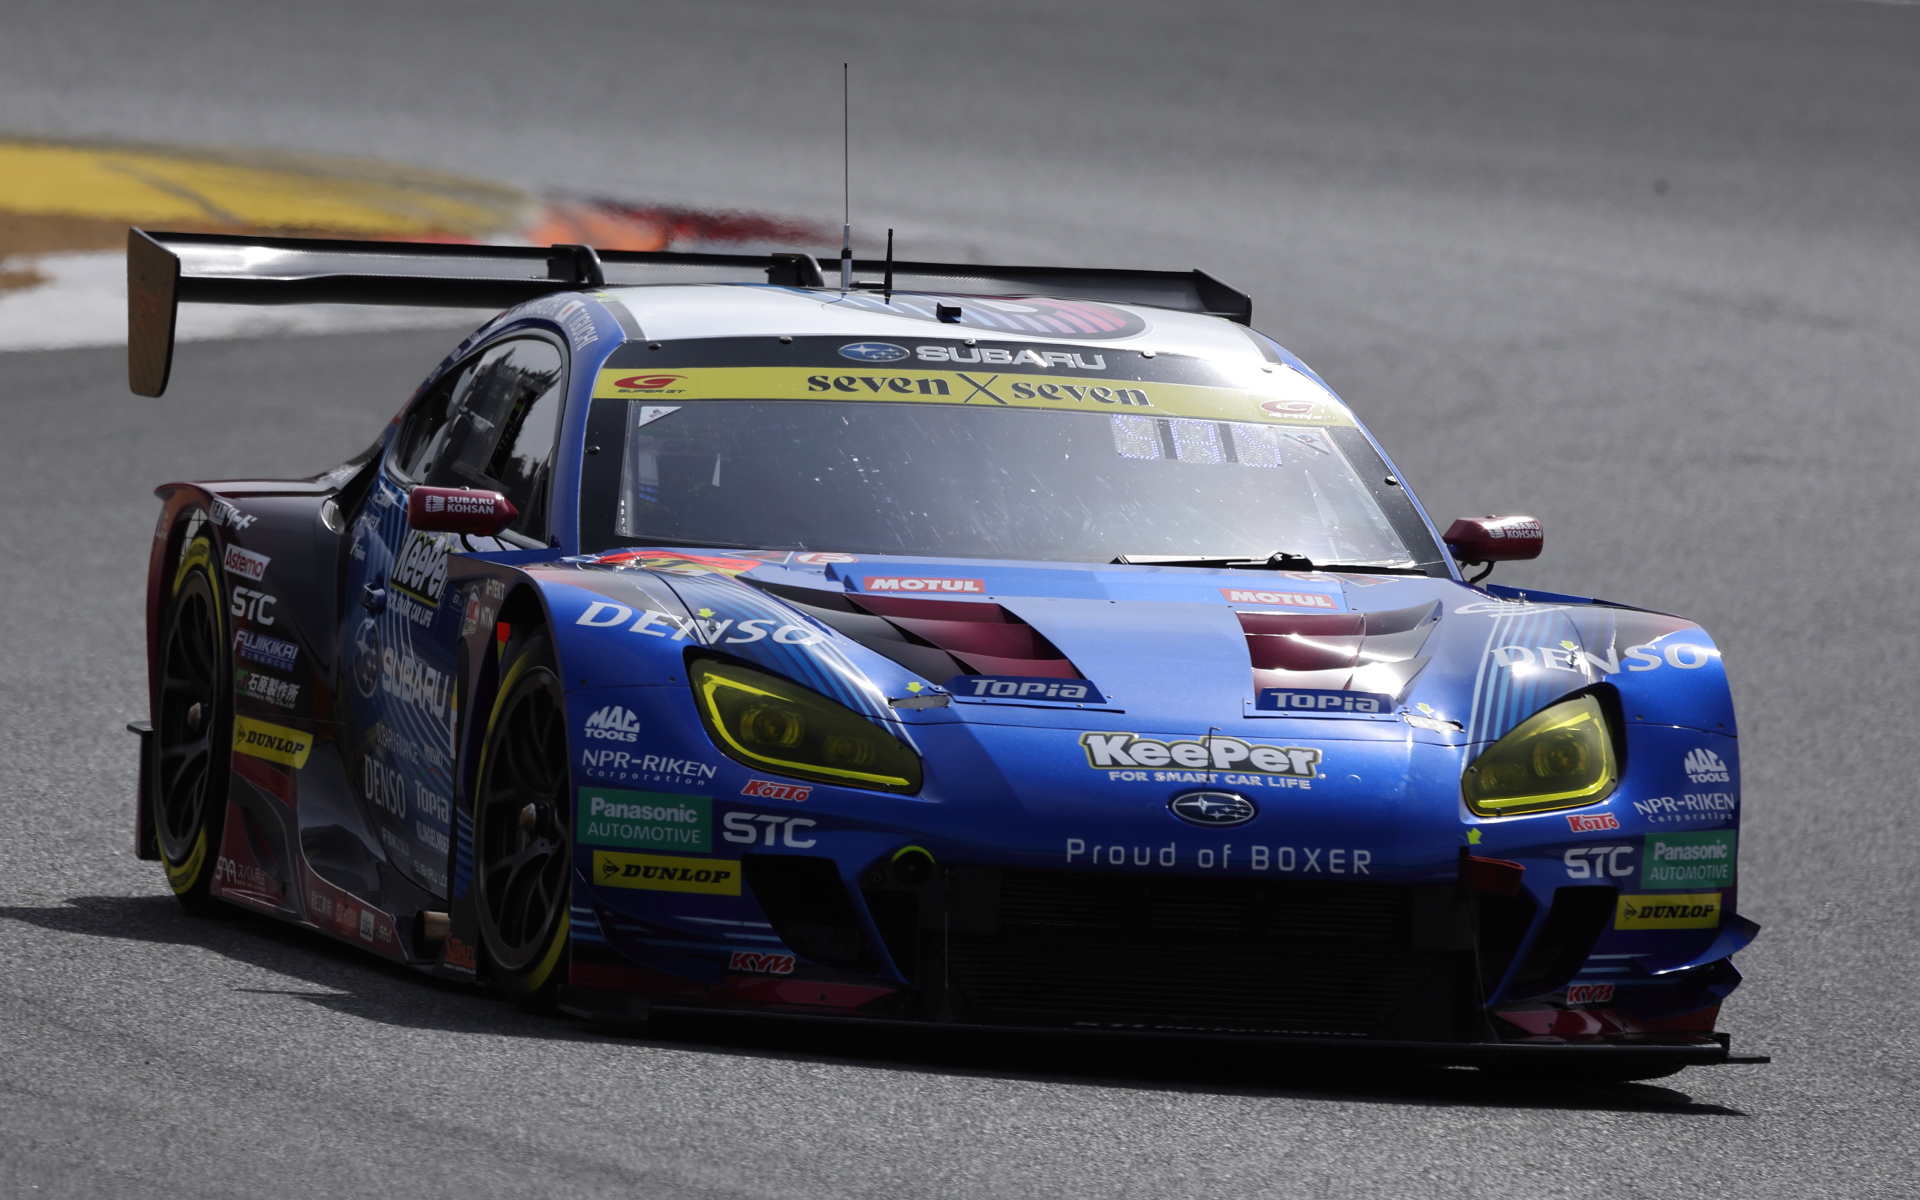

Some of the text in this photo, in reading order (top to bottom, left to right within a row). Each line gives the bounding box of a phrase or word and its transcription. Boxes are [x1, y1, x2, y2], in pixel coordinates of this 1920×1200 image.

[915, 345, 1106, 370] SUBARU
[807, 375, 952, 396] seven
[1012, 382, 1155, 407] seven
[447, 496, 495, 506] SUBARU
[447, 504, 494, 515] KOHSAN
[1506, 530, 1542, 539] KOHSAN
[225, 547, 264, 577] Astemo
[870, 578, 980, 592] MOTUL
[231, 585, 278, 626] STC
[1229, 590, 1332, 607] MOTUL
[410, 604, 422, 623] CAR
[419, 609, 434, 629] LIFE
[480, 606, 494, 631] NTN
[574, 601, 825, 645] DENSO
[233, 630, 299, 660] FUJIKIKAI
[1491, 643, 1709, 675] DENSO
[248, 672, 300, 703] 石原製作所
[382, 647, 450, 719] SUBARU
[585, 705, 640, 733] MAC
[246, 730, 305, 755] DUNLOP
[584, 728, 638, 743] TOOLS
[581, 748, 718, 779] NPR-RIKEN
[1086, 735, 1314, 776] KeePer
[1684, 747, 1728, 774] MAC
[364, 754, 406, 820] DENSO
[586, 768, 705, 786] Corporation
[1109, 771, 1312, 790] FOR SMART CAR LIFE
[1688, 772, 1730, 784] TOOLS
[591, 796, 698, 823] Panasonic
[1633, 793, 1735, 815] NPR-RIKEN
[1648, 811, 1733, 823] Corporation
[587, 822, 701, 844] AUTOMOTIVE
[722, 811, 818, 849] STC
[1066, 838, 1371, 875] Proud of BOXER
[1564, 846, 1635, 879] STC
[1654, 840, 1728, 861] Panasonic
[620, 864, 732, 884] DUNLOP
[1649, 864, 1729, 881] AUTOMOTIVE
[1638, 905, 1715, 919] DUNLOP
[729, 951, 796, 975] KYB
[1566, 983, 1615, 1004] KYB
